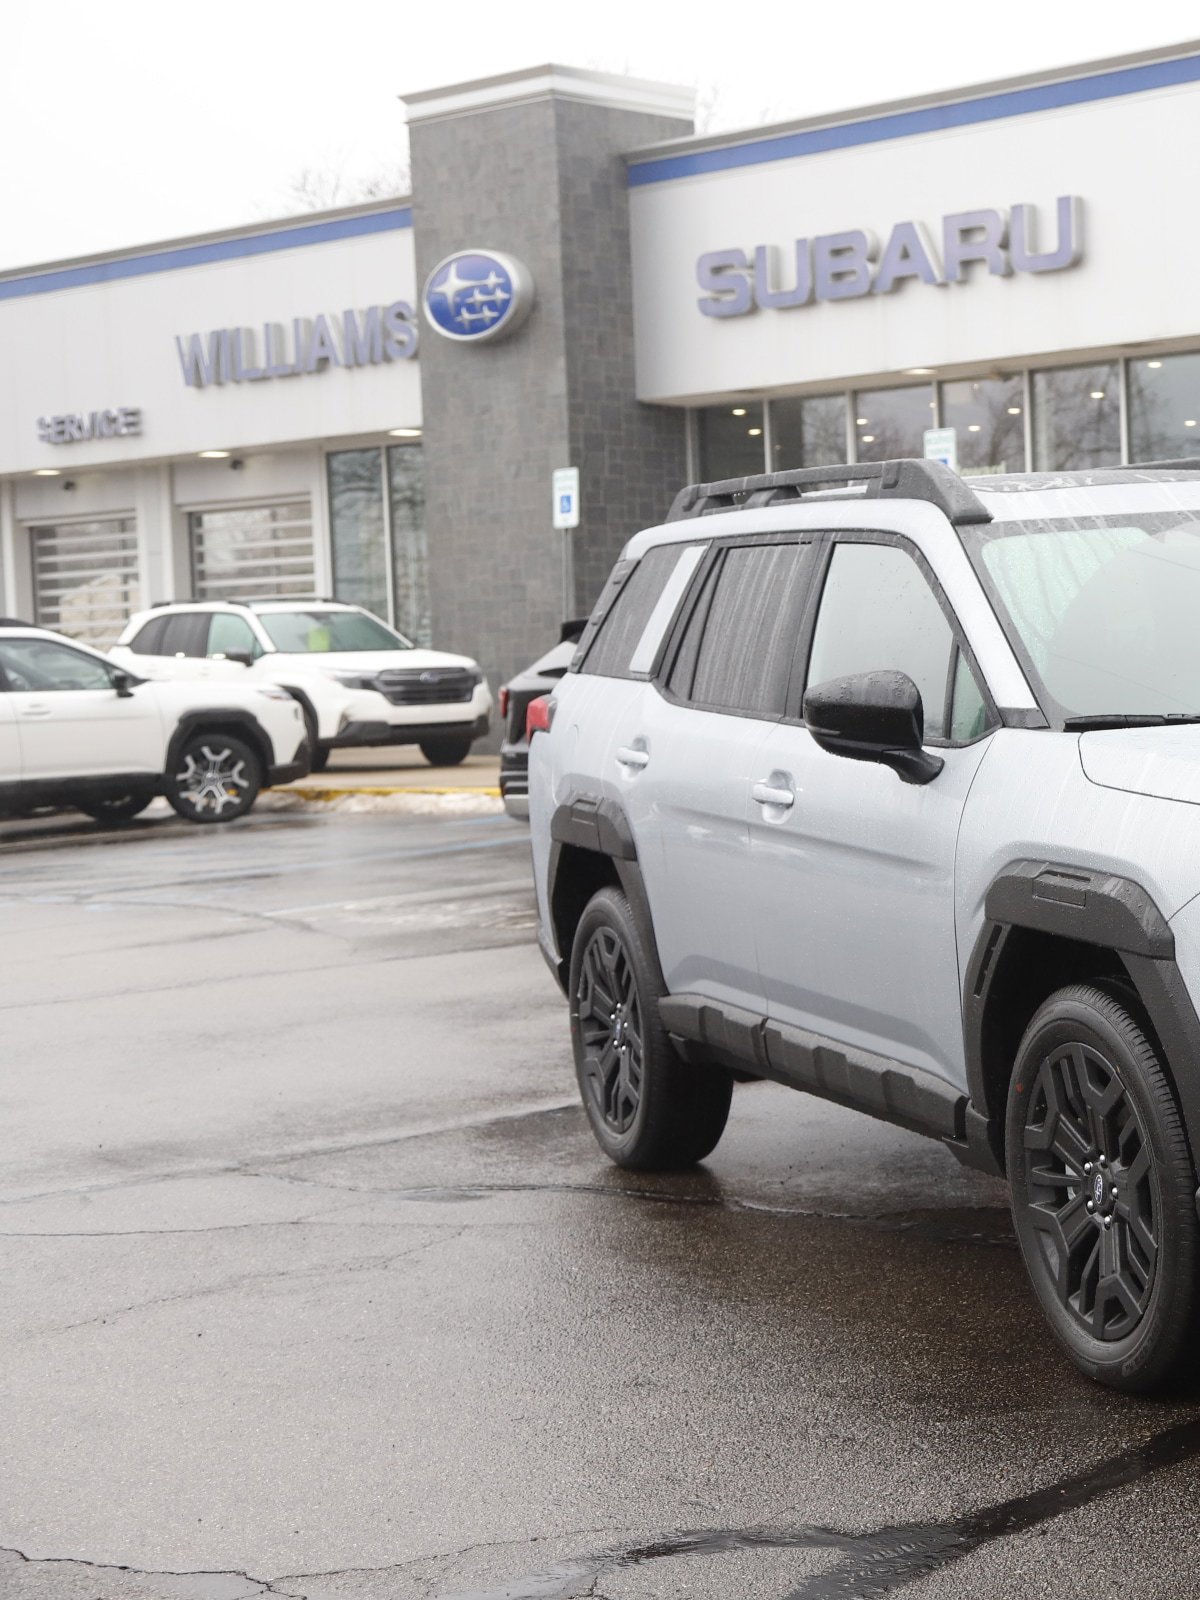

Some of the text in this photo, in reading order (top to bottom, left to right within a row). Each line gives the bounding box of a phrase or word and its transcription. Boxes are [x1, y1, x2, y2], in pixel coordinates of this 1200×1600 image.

[696, 196, 1082, 319] SUBARU
[176, 300, 419, 388] WILLIAMS
[37, 407, 142, 443] SERVICE
